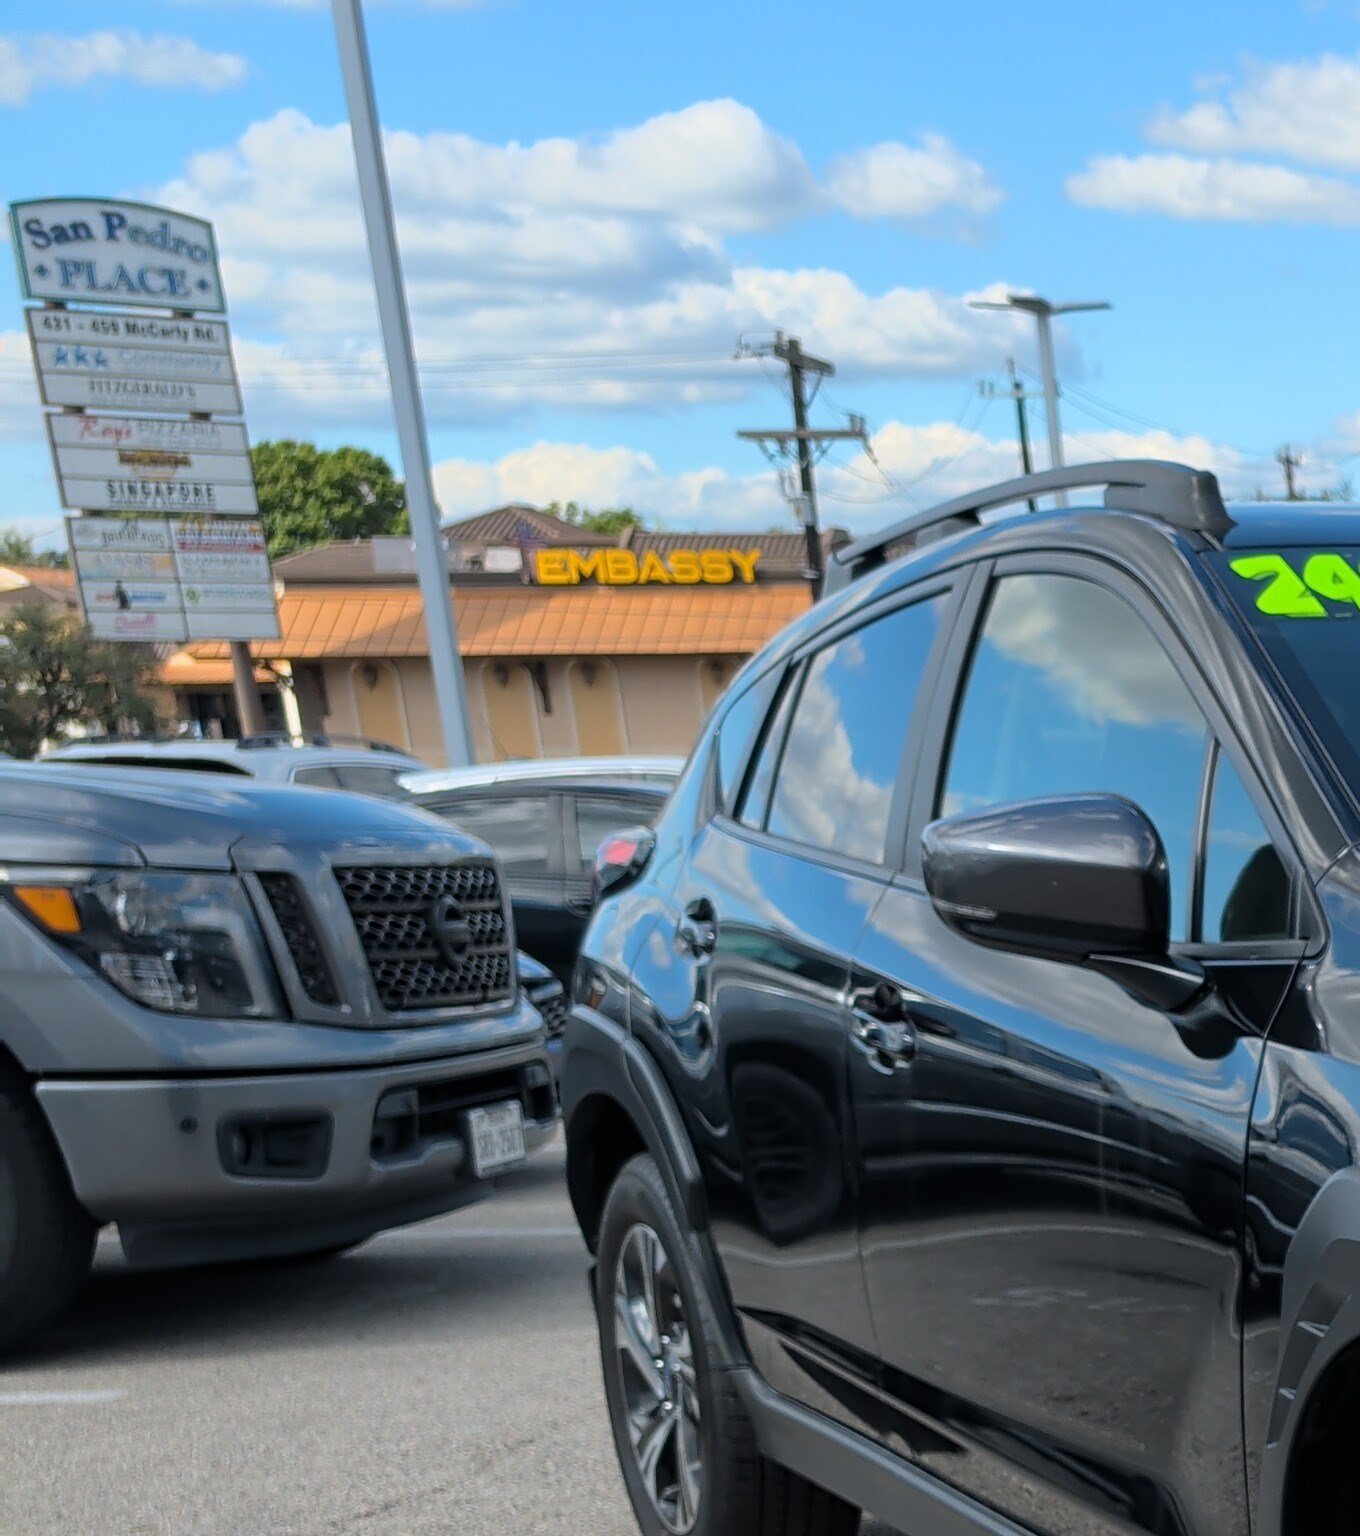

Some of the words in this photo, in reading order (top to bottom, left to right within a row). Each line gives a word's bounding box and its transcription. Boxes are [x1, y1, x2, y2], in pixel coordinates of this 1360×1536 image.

[24, 217, 95, 250] San
[101, 210, 210, 264] Pedro
[55, 257, 193, 297] PLACE
[106, 479, 214, 502] SINGAPORE
[536, 548, 762, 586] EMBASSY
